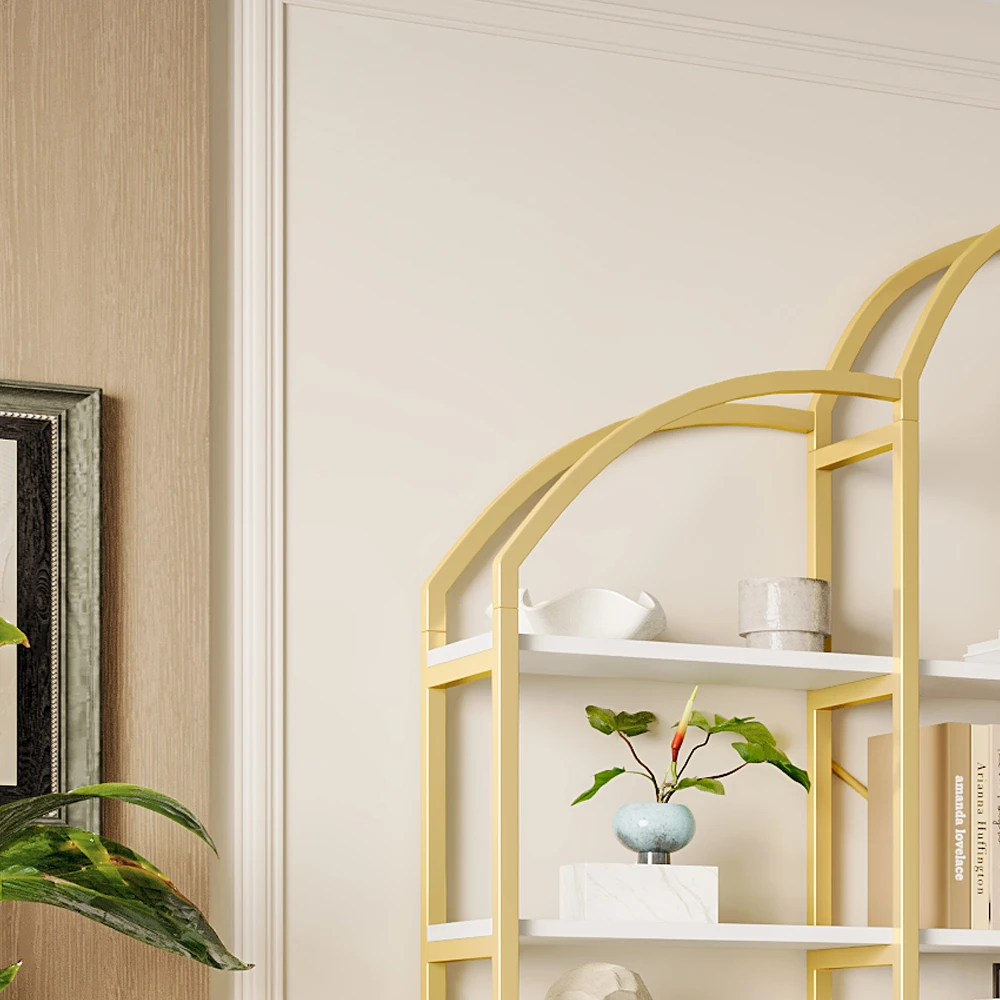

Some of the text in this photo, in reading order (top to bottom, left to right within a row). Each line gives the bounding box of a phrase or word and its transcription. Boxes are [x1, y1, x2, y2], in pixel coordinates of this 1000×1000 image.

[954, 775, 967, 881] amanda lovelace
[974, 762, 988, 895] Arianna Huffington
